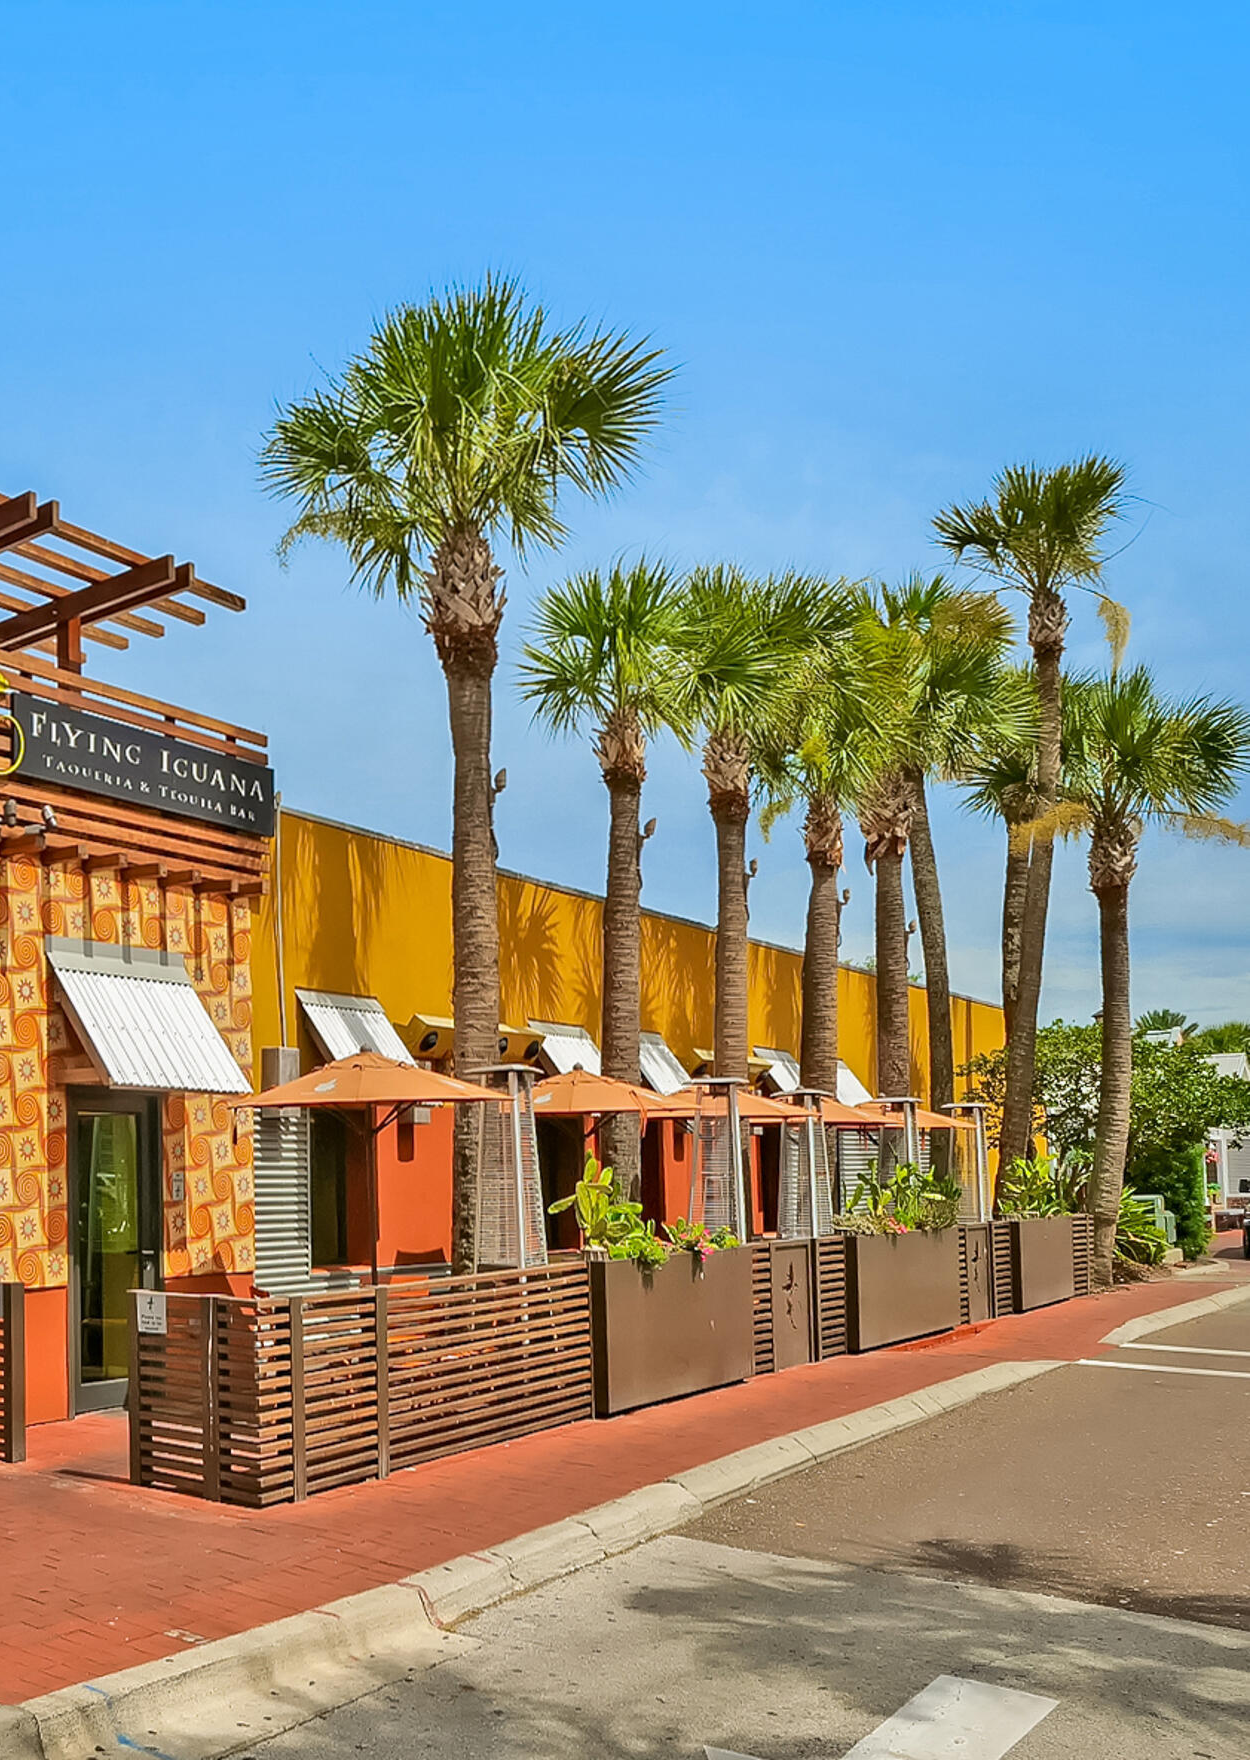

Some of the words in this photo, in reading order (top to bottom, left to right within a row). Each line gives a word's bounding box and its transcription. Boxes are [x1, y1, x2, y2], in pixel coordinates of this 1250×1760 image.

[30, 711, 141, 765] FLYING
[160, 749, 264, 802] IGUANA
[42, 754, 133, 790] TAQUERIA
[140, 781, 150, 793] &
[158, 784, 222, 814] TEQUILA
[230, 804, 256, 822] BAR
